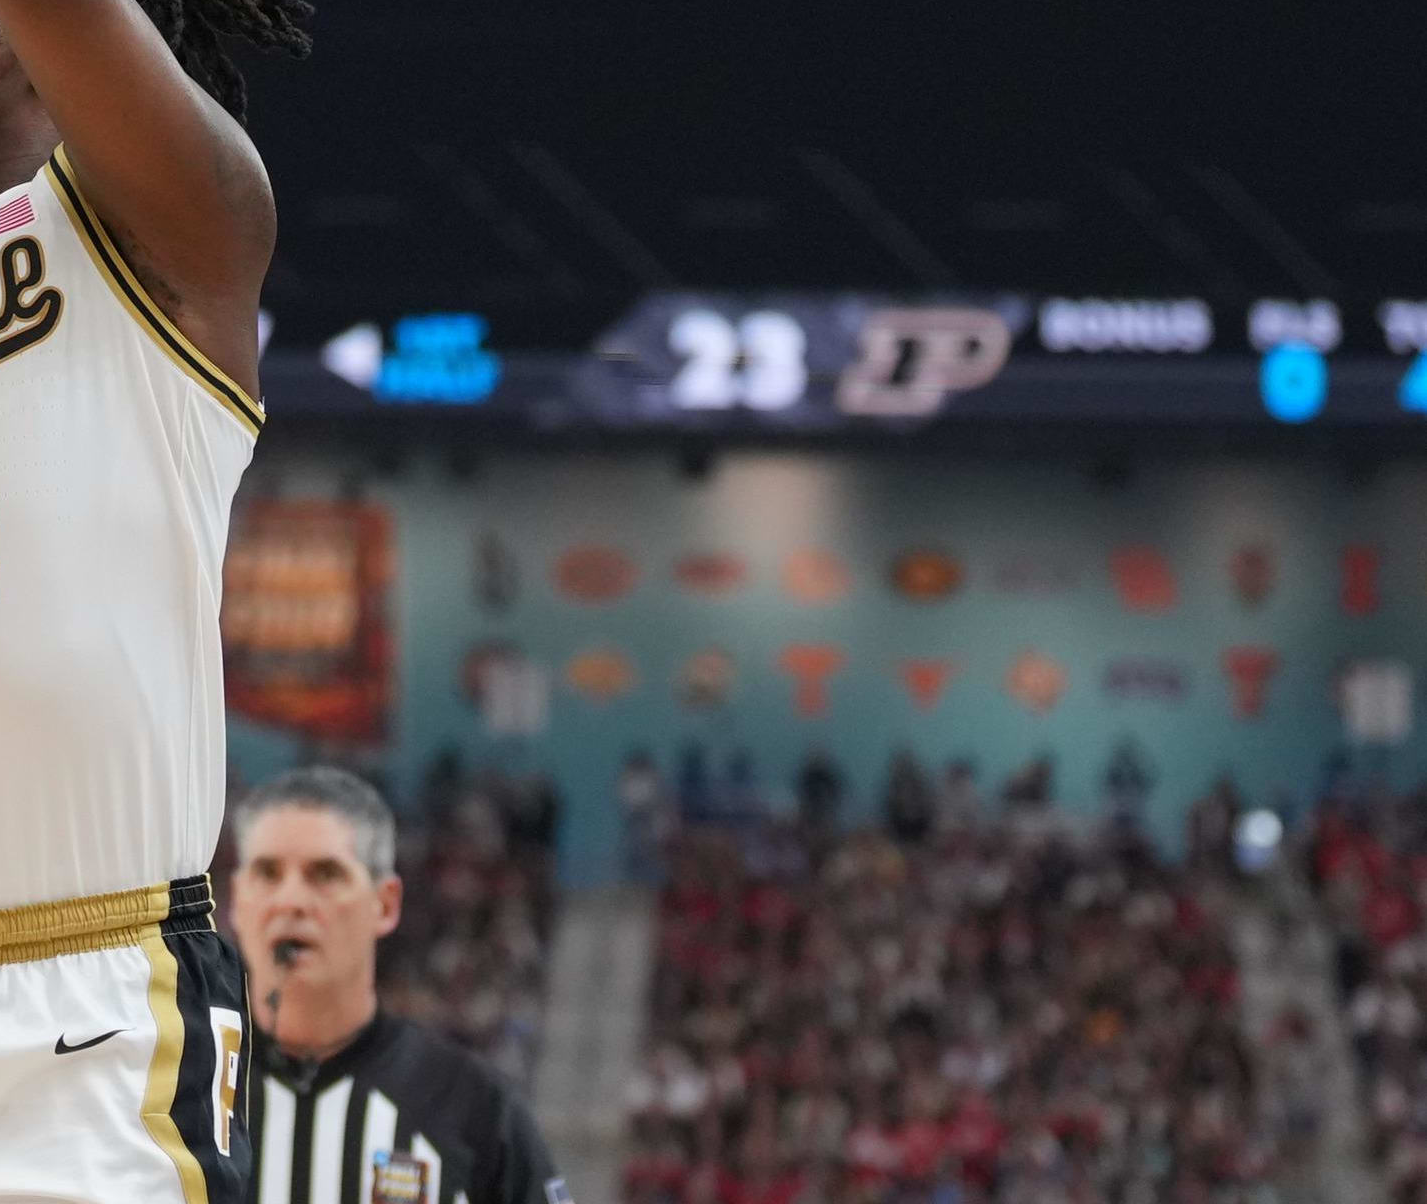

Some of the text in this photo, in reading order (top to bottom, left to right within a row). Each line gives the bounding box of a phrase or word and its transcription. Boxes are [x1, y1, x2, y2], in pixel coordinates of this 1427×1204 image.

[668, 308, 807, 411] 23
[1039, 300, 1213, 353] BONUS
[1259, 339, 1329, 424] 0
